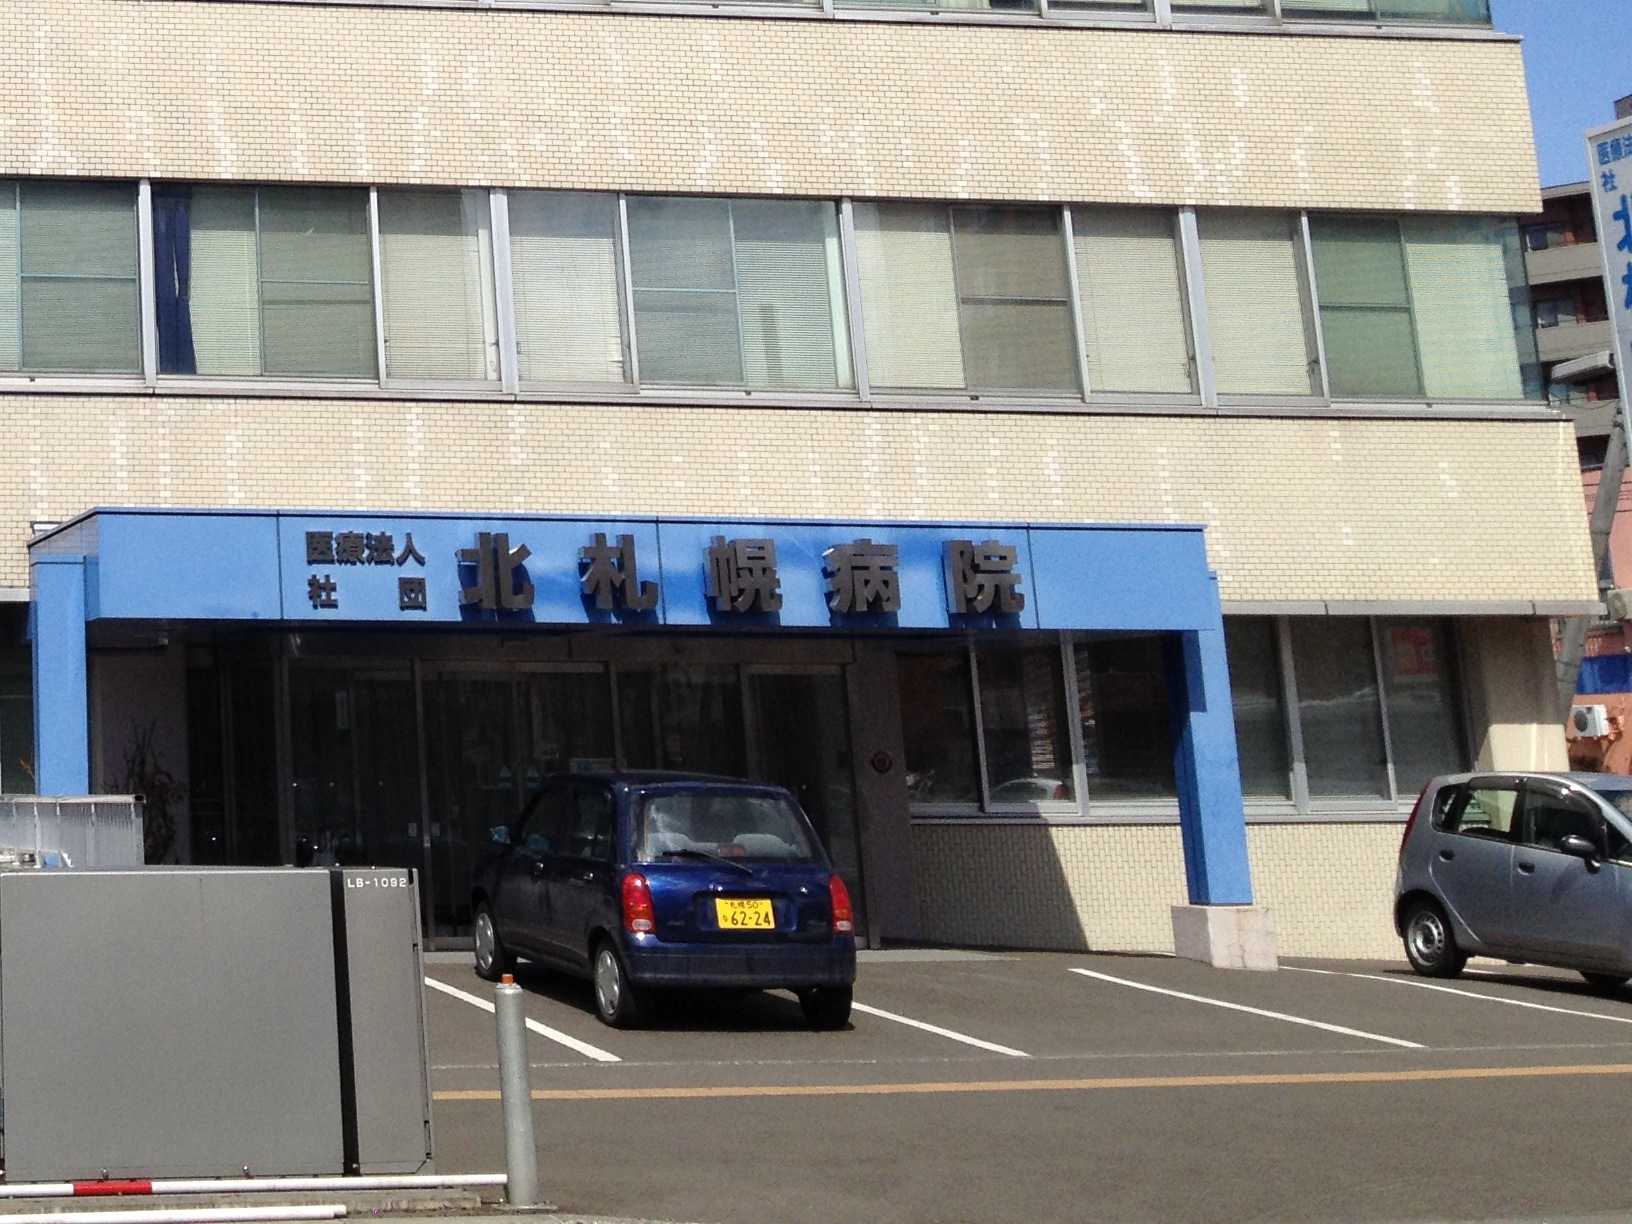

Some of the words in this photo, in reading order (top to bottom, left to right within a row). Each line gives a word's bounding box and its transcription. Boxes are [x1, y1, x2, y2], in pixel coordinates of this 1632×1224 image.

[305, 531, 426, 566] 医療法人
[455, 530, 1025, 615] 北札幌病院
